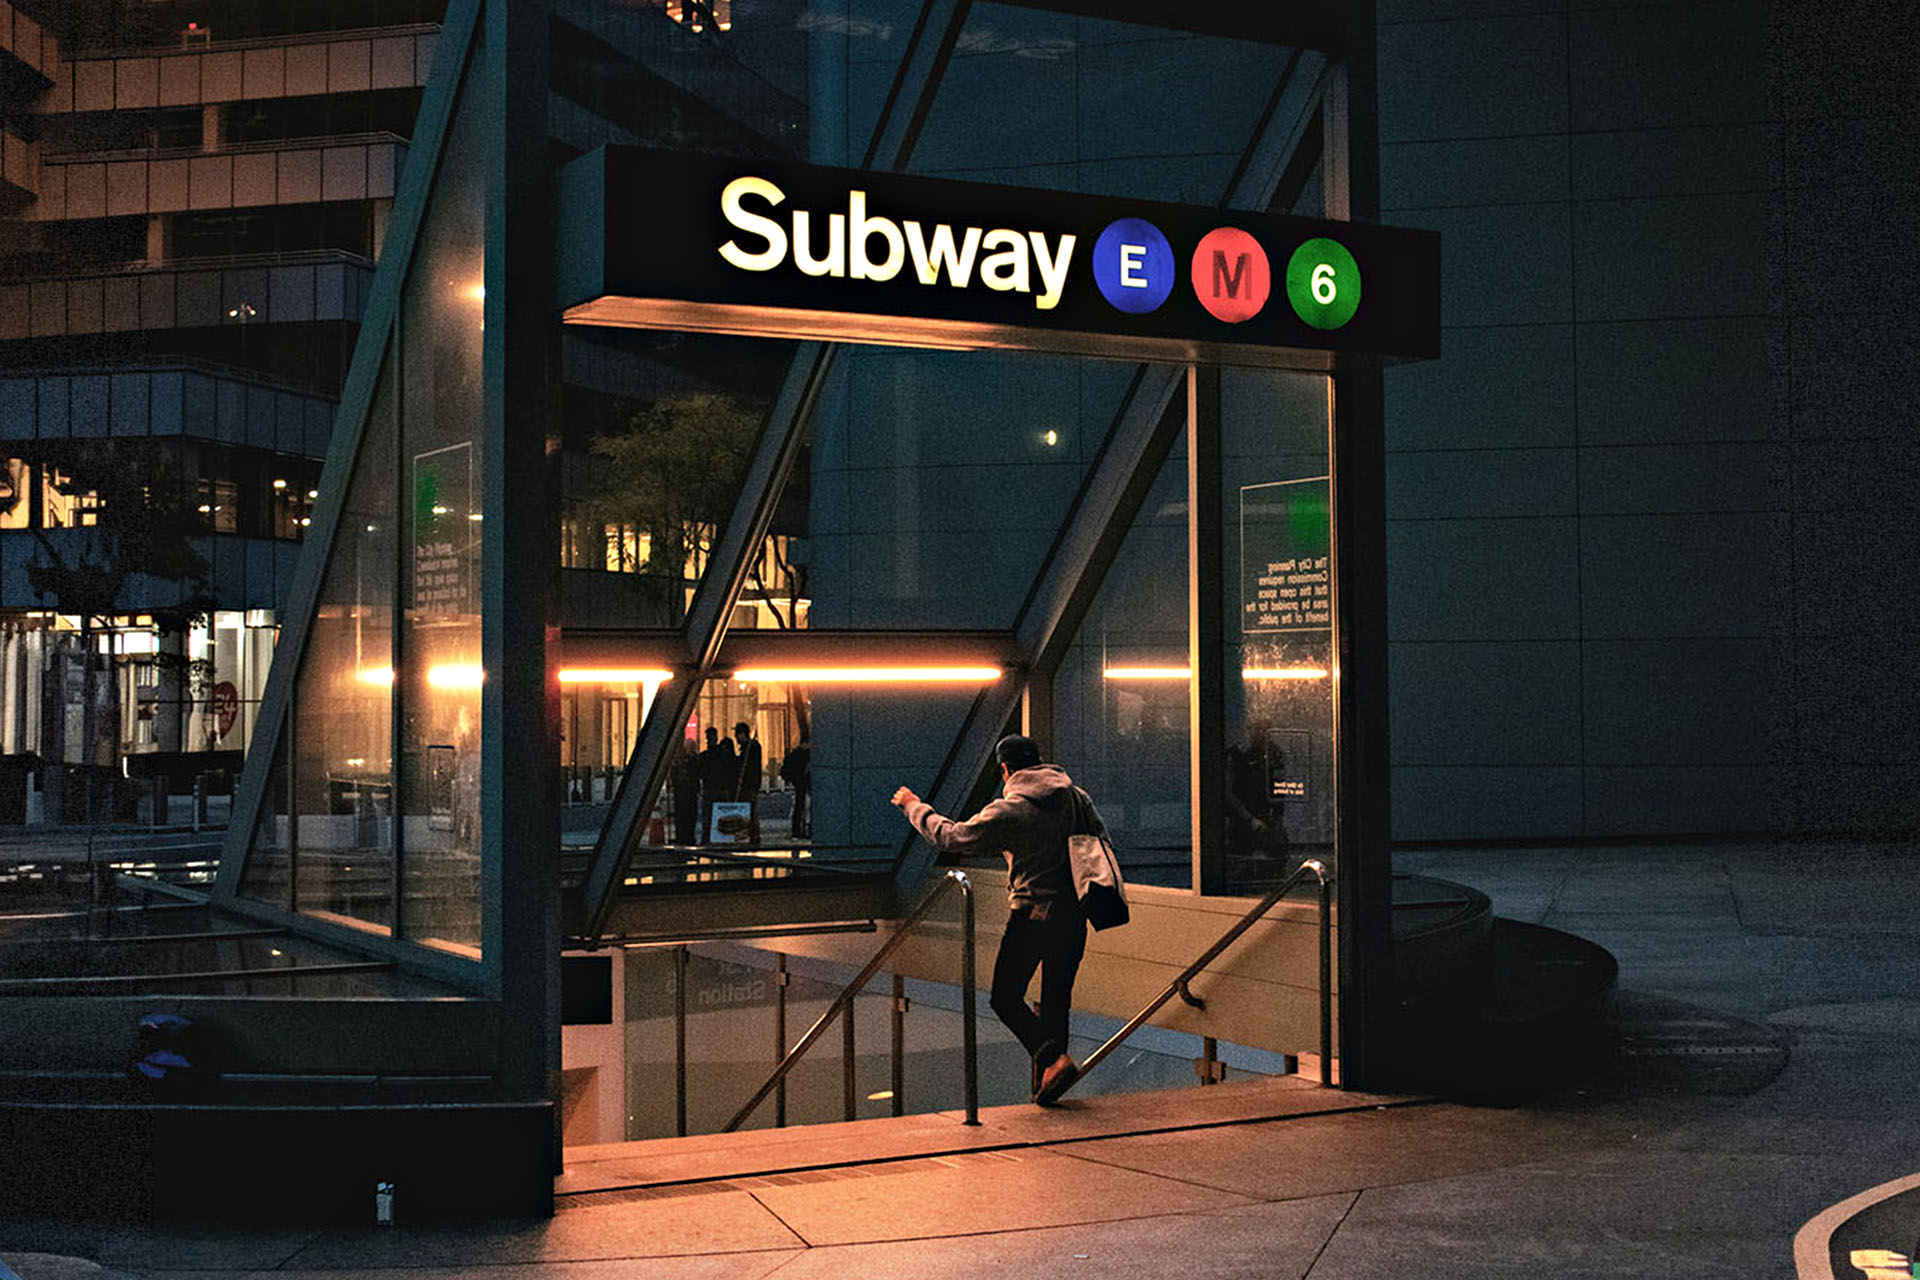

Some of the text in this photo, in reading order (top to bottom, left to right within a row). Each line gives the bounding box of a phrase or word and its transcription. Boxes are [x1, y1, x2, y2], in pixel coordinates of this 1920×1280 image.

[718, 176, 1336, 310] Subway E M 6
